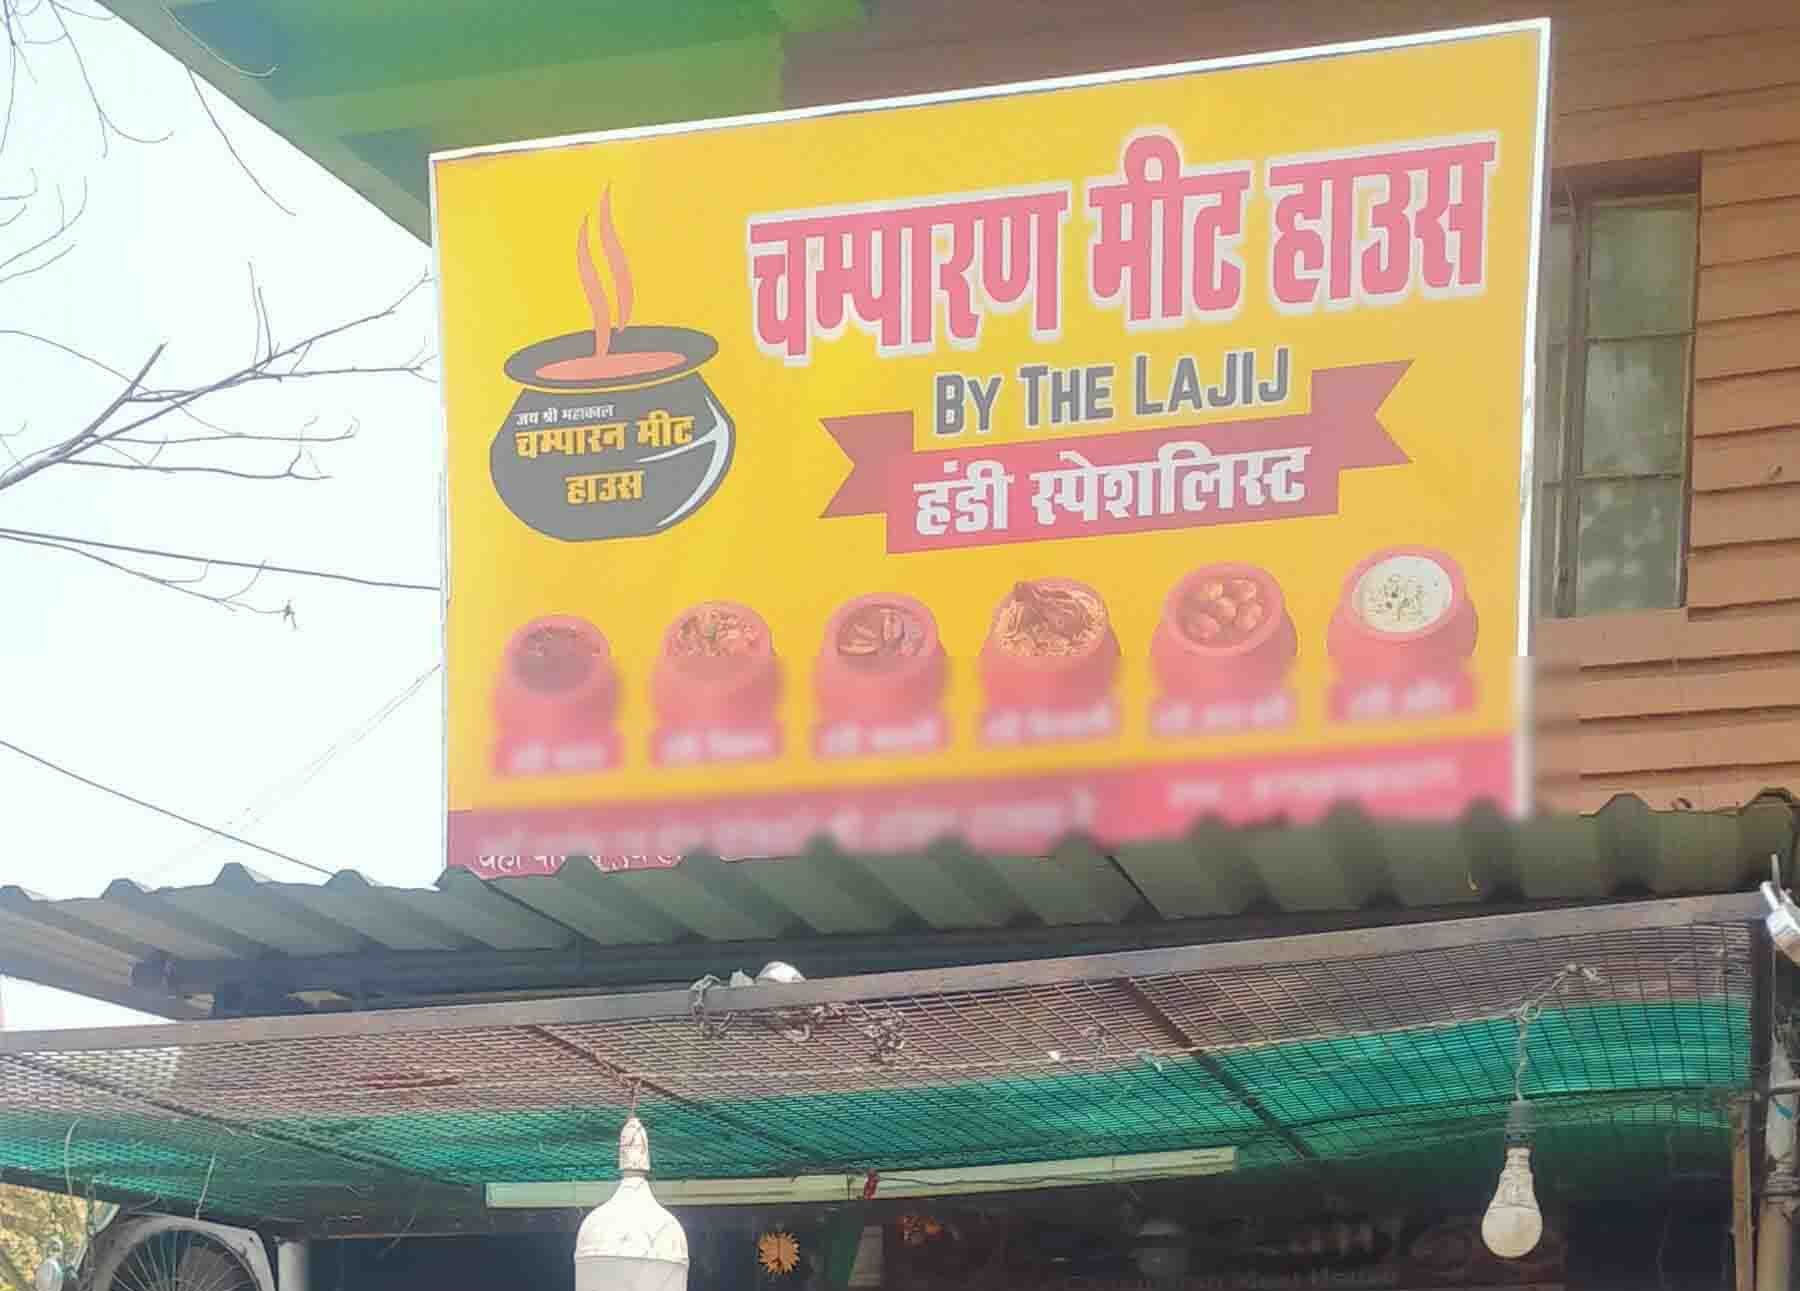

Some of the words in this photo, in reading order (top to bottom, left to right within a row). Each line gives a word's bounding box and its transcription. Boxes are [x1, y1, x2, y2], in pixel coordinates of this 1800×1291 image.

[747, 187, 1070, 361] चम्पारण
[1087, 131, 1253, 325] मीट
[1267, 136, 1498, 307] हाउस
[514, 421, 629, 459] चम्पारन
[636, 409, 696, 448] मीट
[936, 374, 1002, 435] BY
[1019, 364, 1114, 427] THE
[1135, 346, 1290, 416] LAJIJ
[564, 469, 646, 505] हाउस
[912, 458, 1014, 535] हंडी
[1030, 440, 1313, 527] स्पेशलिस्ट
